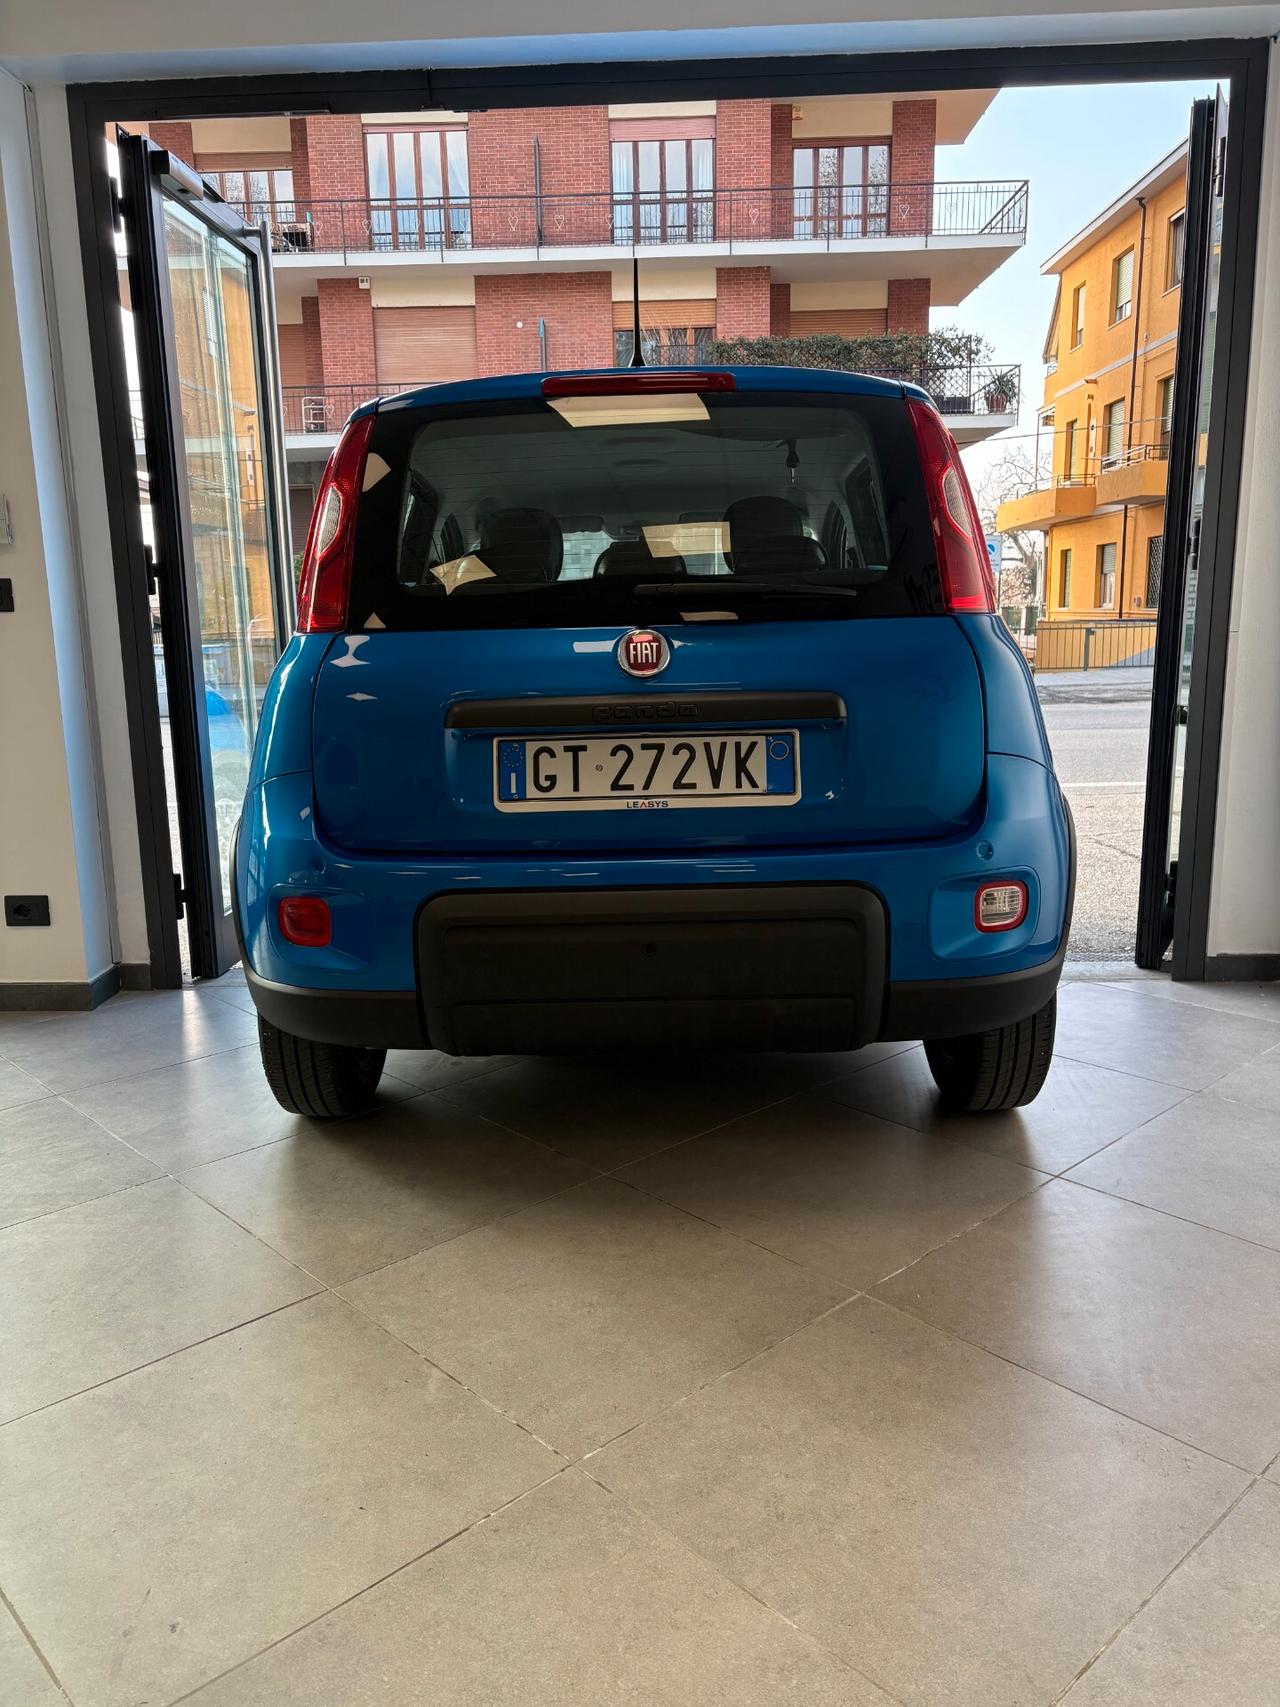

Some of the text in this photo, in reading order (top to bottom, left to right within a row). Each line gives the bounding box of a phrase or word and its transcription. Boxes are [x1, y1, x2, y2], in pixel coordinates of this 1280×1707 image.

[630, 642, 659, 664] FIAT
[533, 741, 760, 793] GT 272VK
[626, 800, 669, 809] LEASYS
